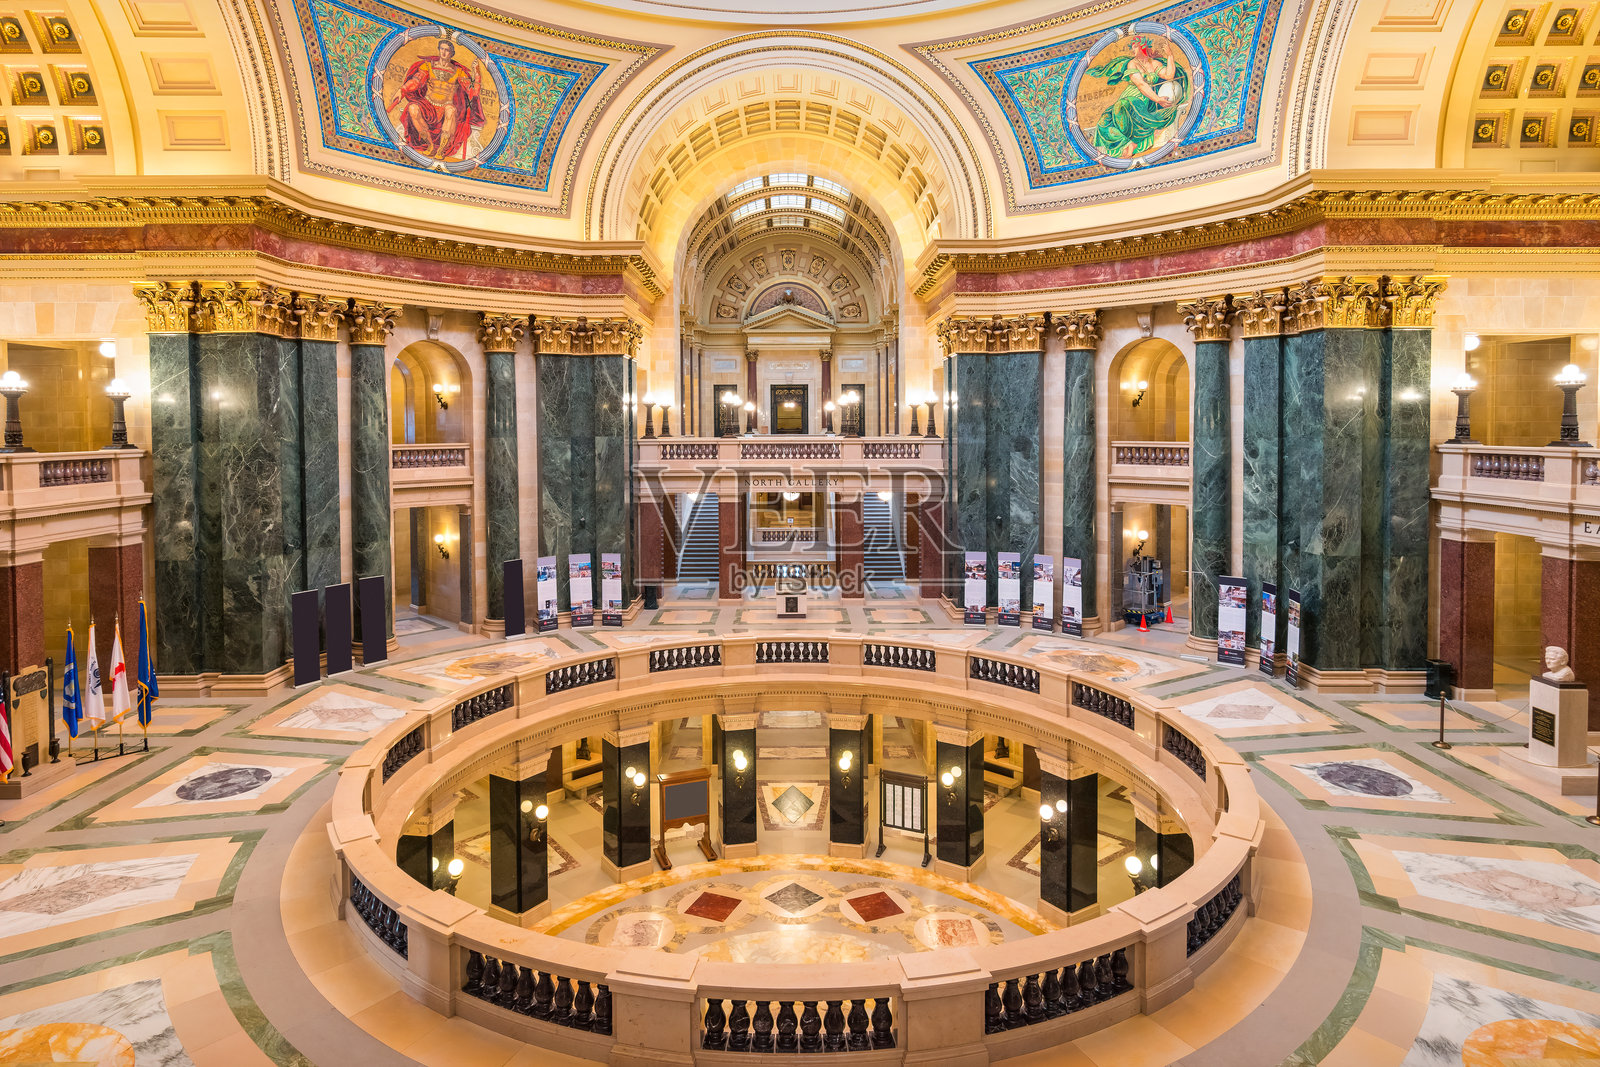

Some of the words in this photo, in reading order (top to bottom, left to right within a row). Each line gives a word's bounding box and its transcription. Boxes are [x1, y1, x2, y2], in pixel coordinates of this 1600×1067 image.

[1078, 86, 1116, 102] LIBERTY
[744, 479, 782, 487] NORTH
[788, 479, 839, 487] GALLERY
